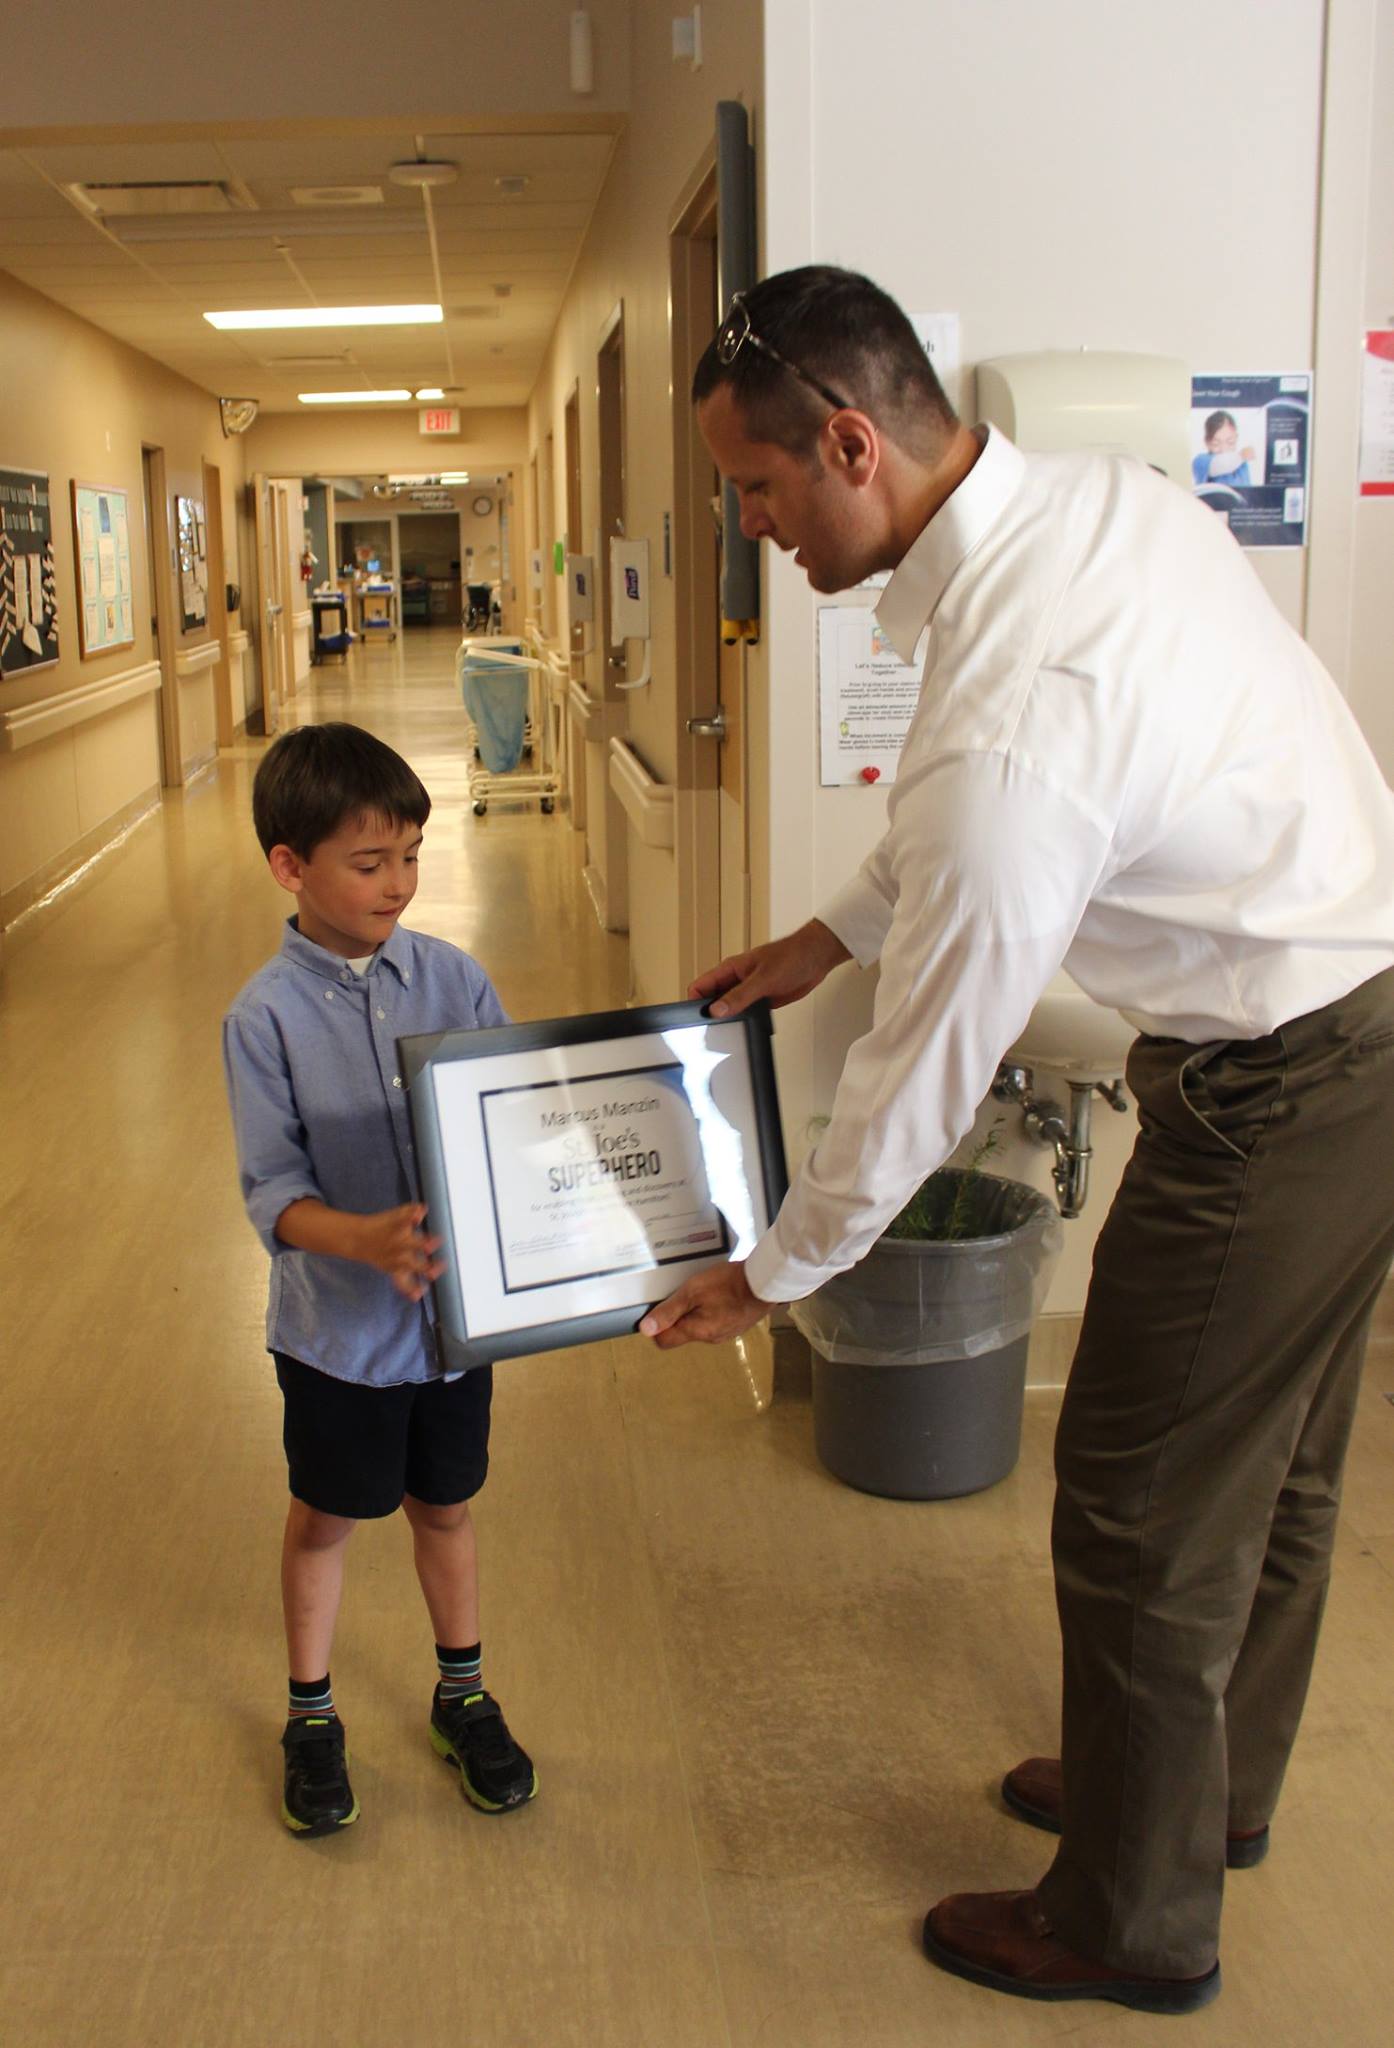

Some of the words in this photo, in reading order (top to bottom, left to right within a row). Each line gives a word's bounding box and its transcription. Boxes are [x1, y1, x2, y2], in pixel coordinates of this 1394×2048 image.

[426, 409, 452, 431] EXIT
[541, 1108, 600, 1128] Marcus
[594, 1127, 640, 1157] Joe's
[548, 1150, 661, 1193] SUPERHERO
